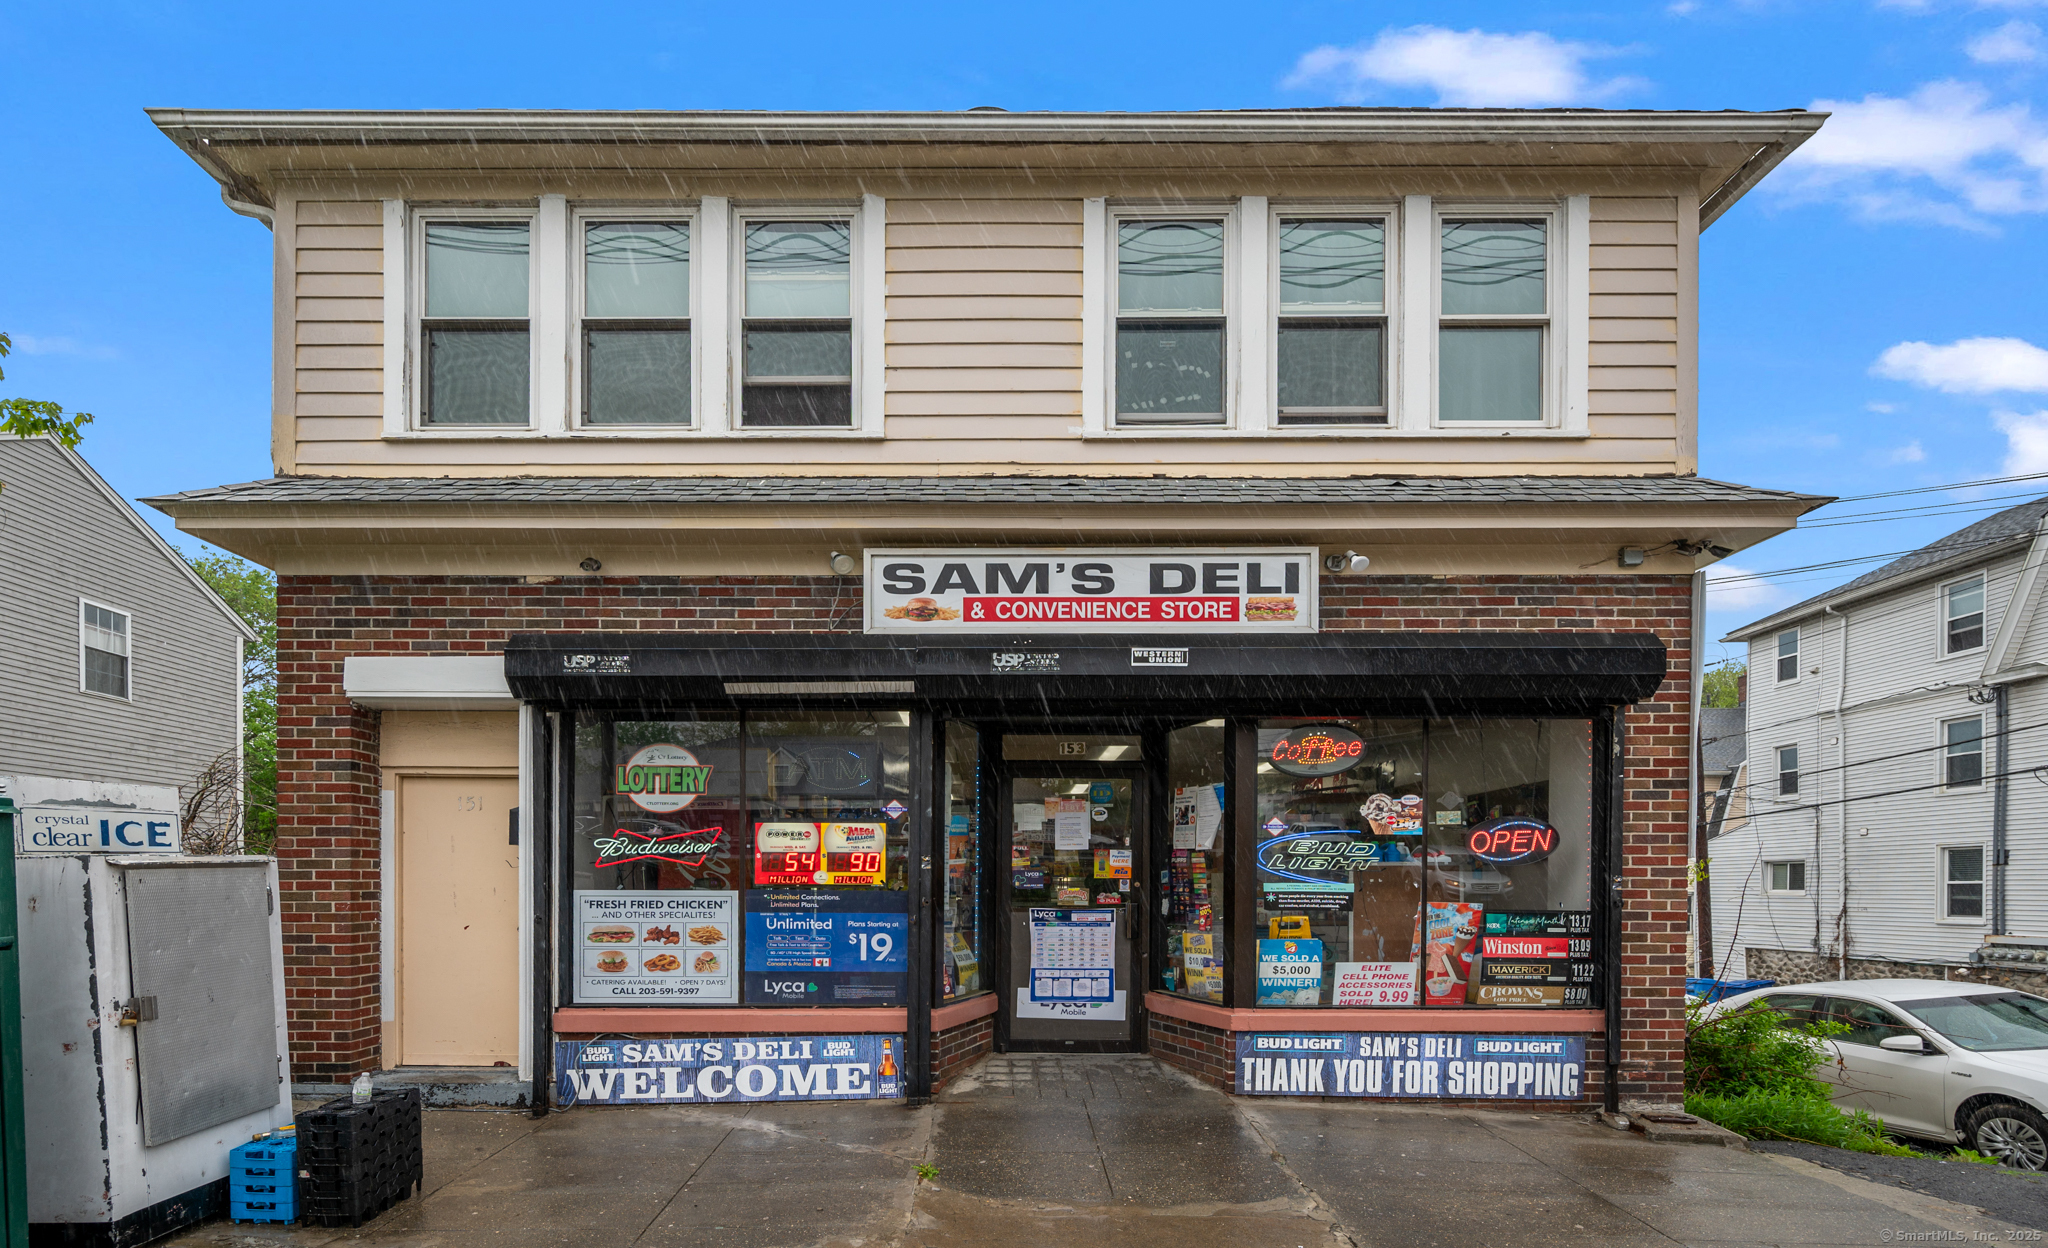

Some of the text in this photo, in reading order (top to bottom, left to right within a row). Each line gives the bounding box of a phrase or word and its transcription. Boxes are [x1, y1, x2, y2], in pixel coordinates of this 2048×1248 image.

[882, 563, 1300, 595] SAM'S DELI
[969, 601, 1233, 619] & CONVENIENCE STORE
[1060, 742, 1085, 754] 153
[1272, 738, 1362, 761] Coffee
[617, 766, 710, 793] LOTTERY
[458, 796, 483, 812] 151
[34, 814, 89, 827] crystal
[32, 827, 93, 848] clear
[99, 818, 172, 848] ICE
[847, 826, 875, 836] MEGA
[593, 837, 719, 858] Budweiser
[1470, 829, 1552, 853] OPEN
[1288, 840, 1377, 856] BUD
[785, 852, 816, 872] 54
[850, 852, 881, 872] 90
[1267, 854, 1380, 870] LIGHT
[769, 876, 808, 884] MILLION
[834, 876, 873, 884] MILLION
[630, 900, 664, 909] FRIED
[1034, 910, 1056, 918] Lyca
[766, 918, 832, 930] Unlimited
[866, 921, 891, 929] Starting
[1429, 917, 1450, 930] COOL
[1430, 927, 1454, 940] ZONE
[848, 933, 893, 961] $19
[1484, 939, 1543, 955] Winston
[1272, 965, 1311, 976] $5,000
[1492, 966, 1547, 974] MAVERICK
[764, 979, 805, 995] Lyca
[1261, 978, 1318, 987] WINNER!
[1379, 990, 1409, 1003] 9.99
[1480, 986, 1544, 999] CROWNS
[1564, 988, 1588, 1000] $8.00
[1060, 1008, 1087, 1016] Mobile
[826, 1041, 852, 1049] BUD
[1257, 1036, 1343, 1050] BUD LIGHT
[1359, 1036, 1462, 1058] SAM'S DELI
[1477, 1040, 1563, 1054] BUD LIGHT
[586, 1046, 610, 1055] BUD
[622, 1040, 813, 1063] SAM'S DELI
[822, 1048, 856, 1057] LIGHT
[582, 1053, 615, 1062] LIGHT
[565, 1062, 871, 1100] WELCOME
[1241, 1057, 1579, 1096] THANK YOU FOR SHOPPING
